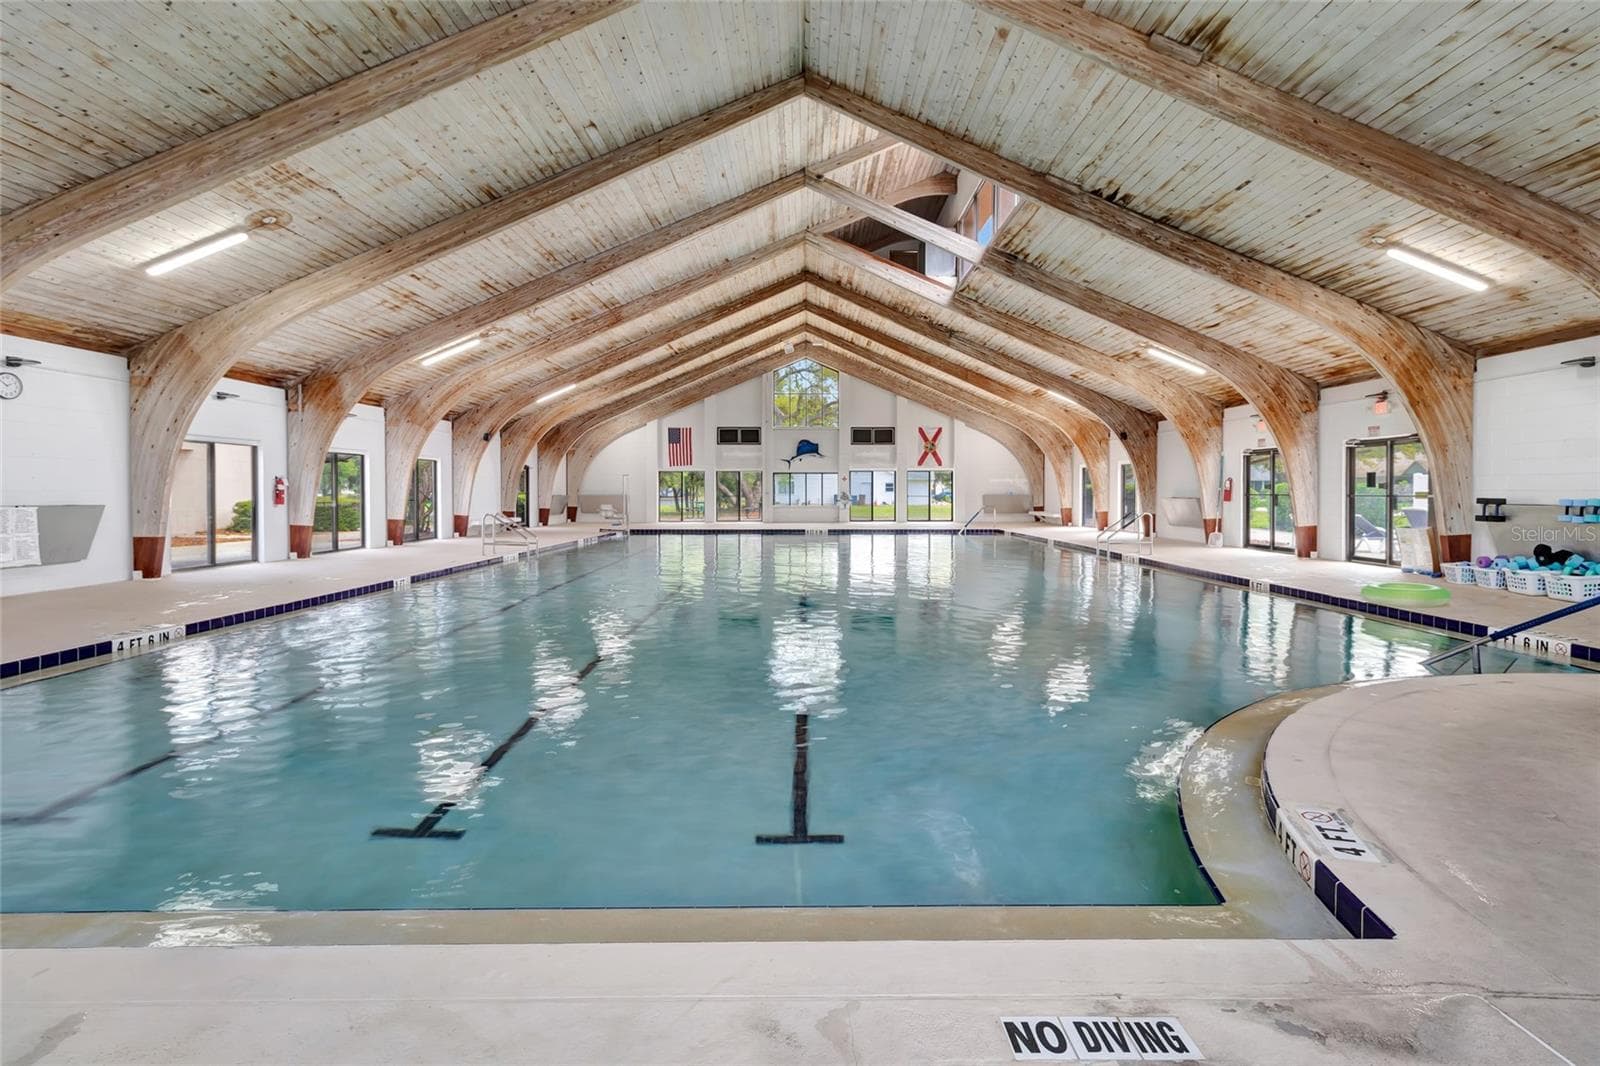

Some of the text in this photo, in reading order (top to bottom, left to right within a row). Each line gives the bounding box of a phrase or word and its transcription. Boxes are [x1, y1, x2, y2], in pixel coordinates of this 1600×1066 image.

[117, 631, 169, 651] 4 FT 6 IN
[1523, 637, 1530, 648] 6
[1536, 639, 1549, 652] IN
[1285, 832, 1297, 864] FT
[1333, 846, 1366, 857] 4
[1003, 1021, 1190, 1054] NO DIVING
